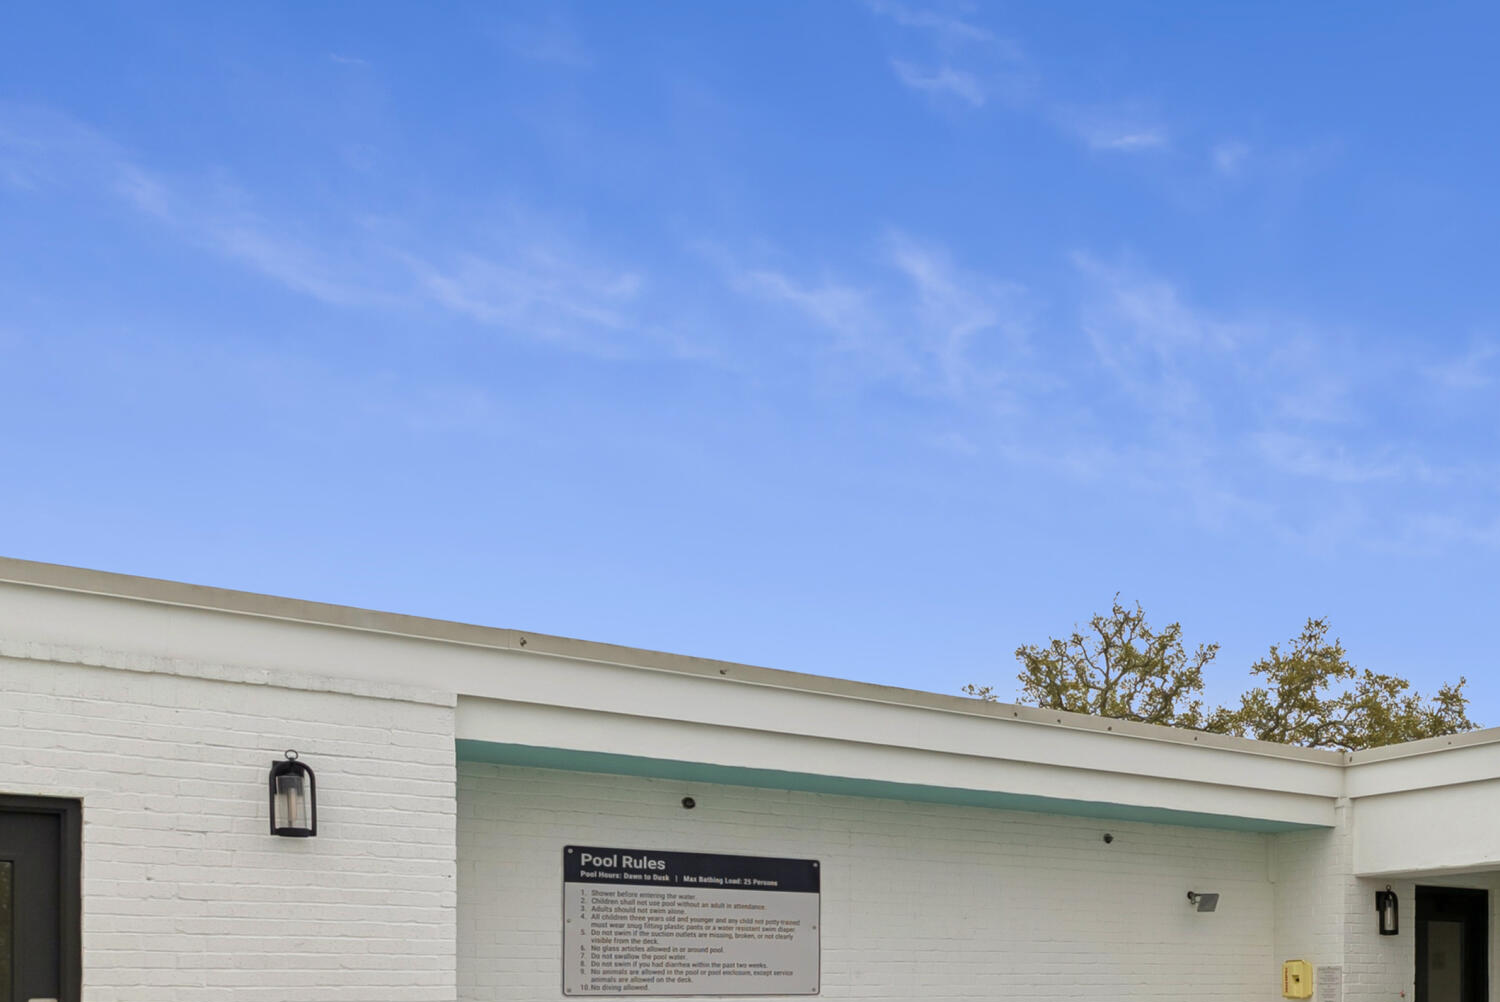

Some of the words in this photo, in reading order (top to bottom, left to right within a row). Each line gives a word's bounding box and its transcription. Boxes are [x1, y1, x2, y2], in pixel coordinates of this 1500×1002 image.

[581, 853, 617, 868] Pool
[622, 855, 666, 870] Rules
[580, 870, 597, 878] Pool
[623, 872, 642, 880] Dawn
[699, 876, 723, 885] Bathing
[744, 878, 752, 886] 25
[753, 879, 778, 887] Persons
